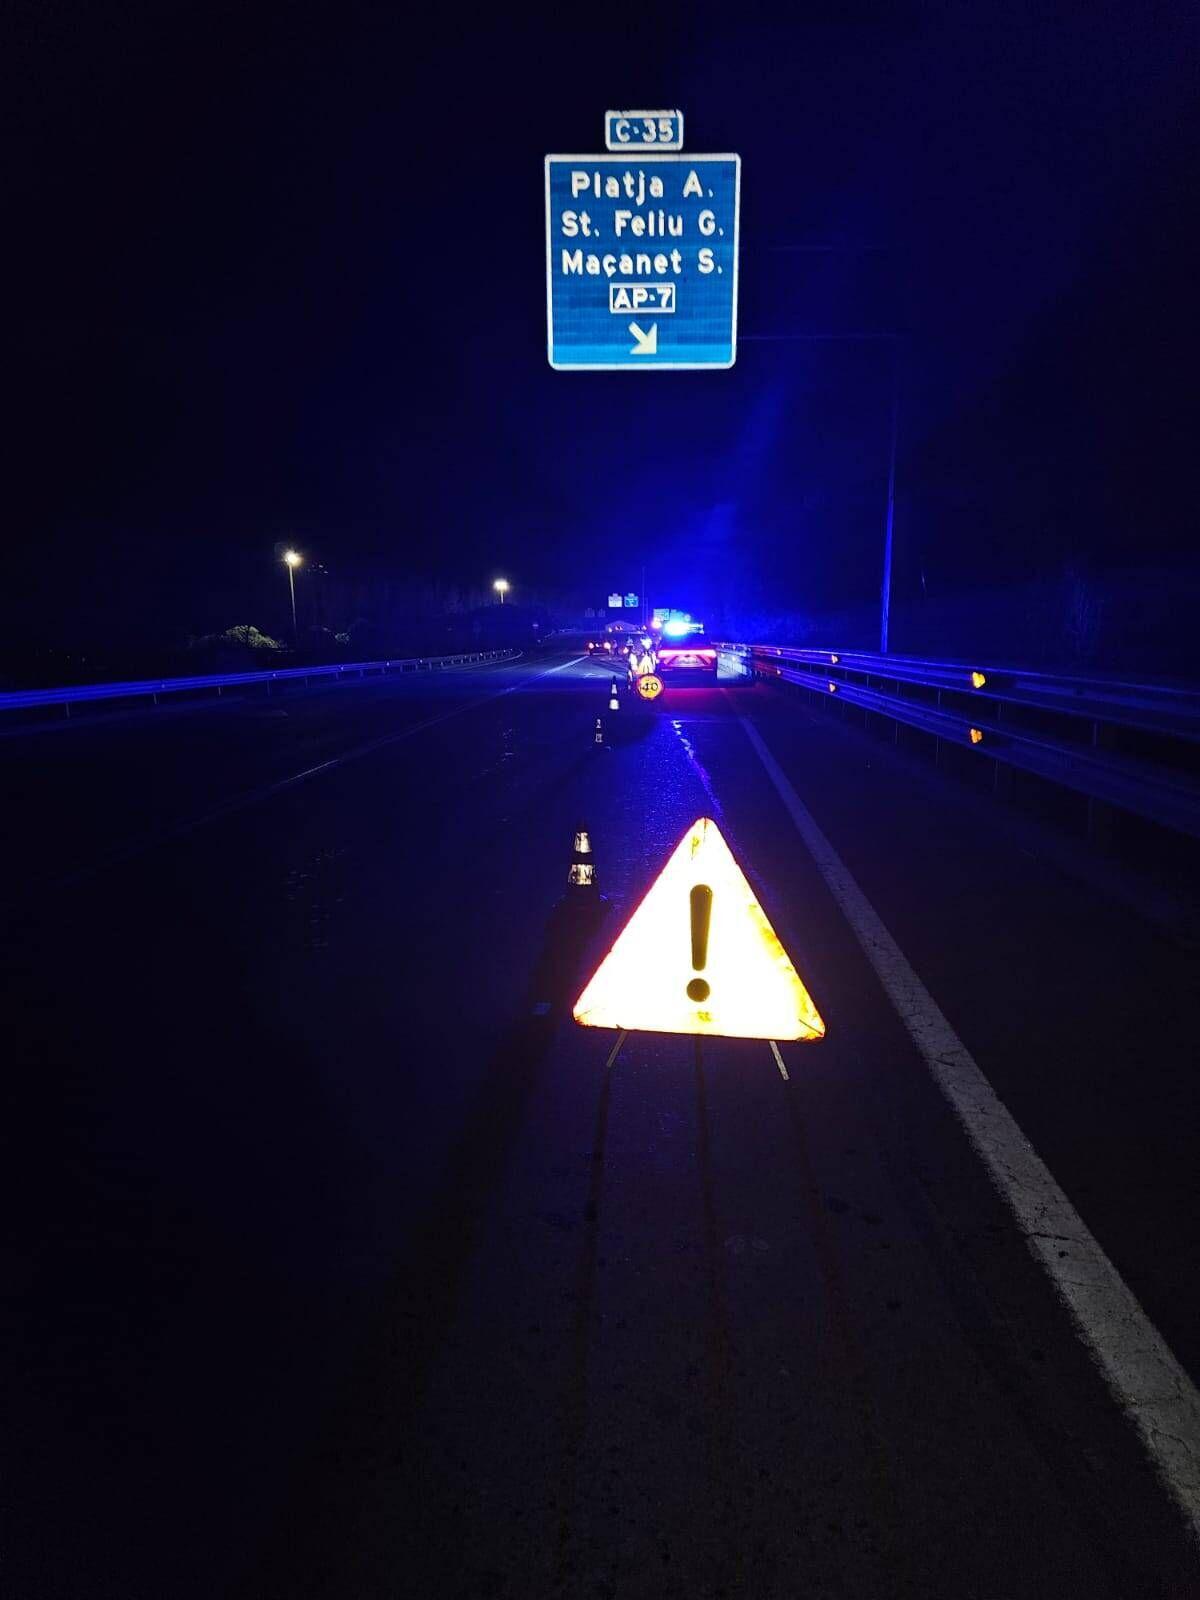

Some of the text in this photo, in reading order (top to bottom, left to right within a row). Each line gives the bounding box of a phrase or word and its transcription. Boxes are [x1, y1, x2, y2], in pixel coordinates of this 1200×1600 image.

[571, 170, 714, 206] Platja A.
[561, 209, 725, 237] St. Feliu G.
[562, 248, 723, 277] Maçanet S.
